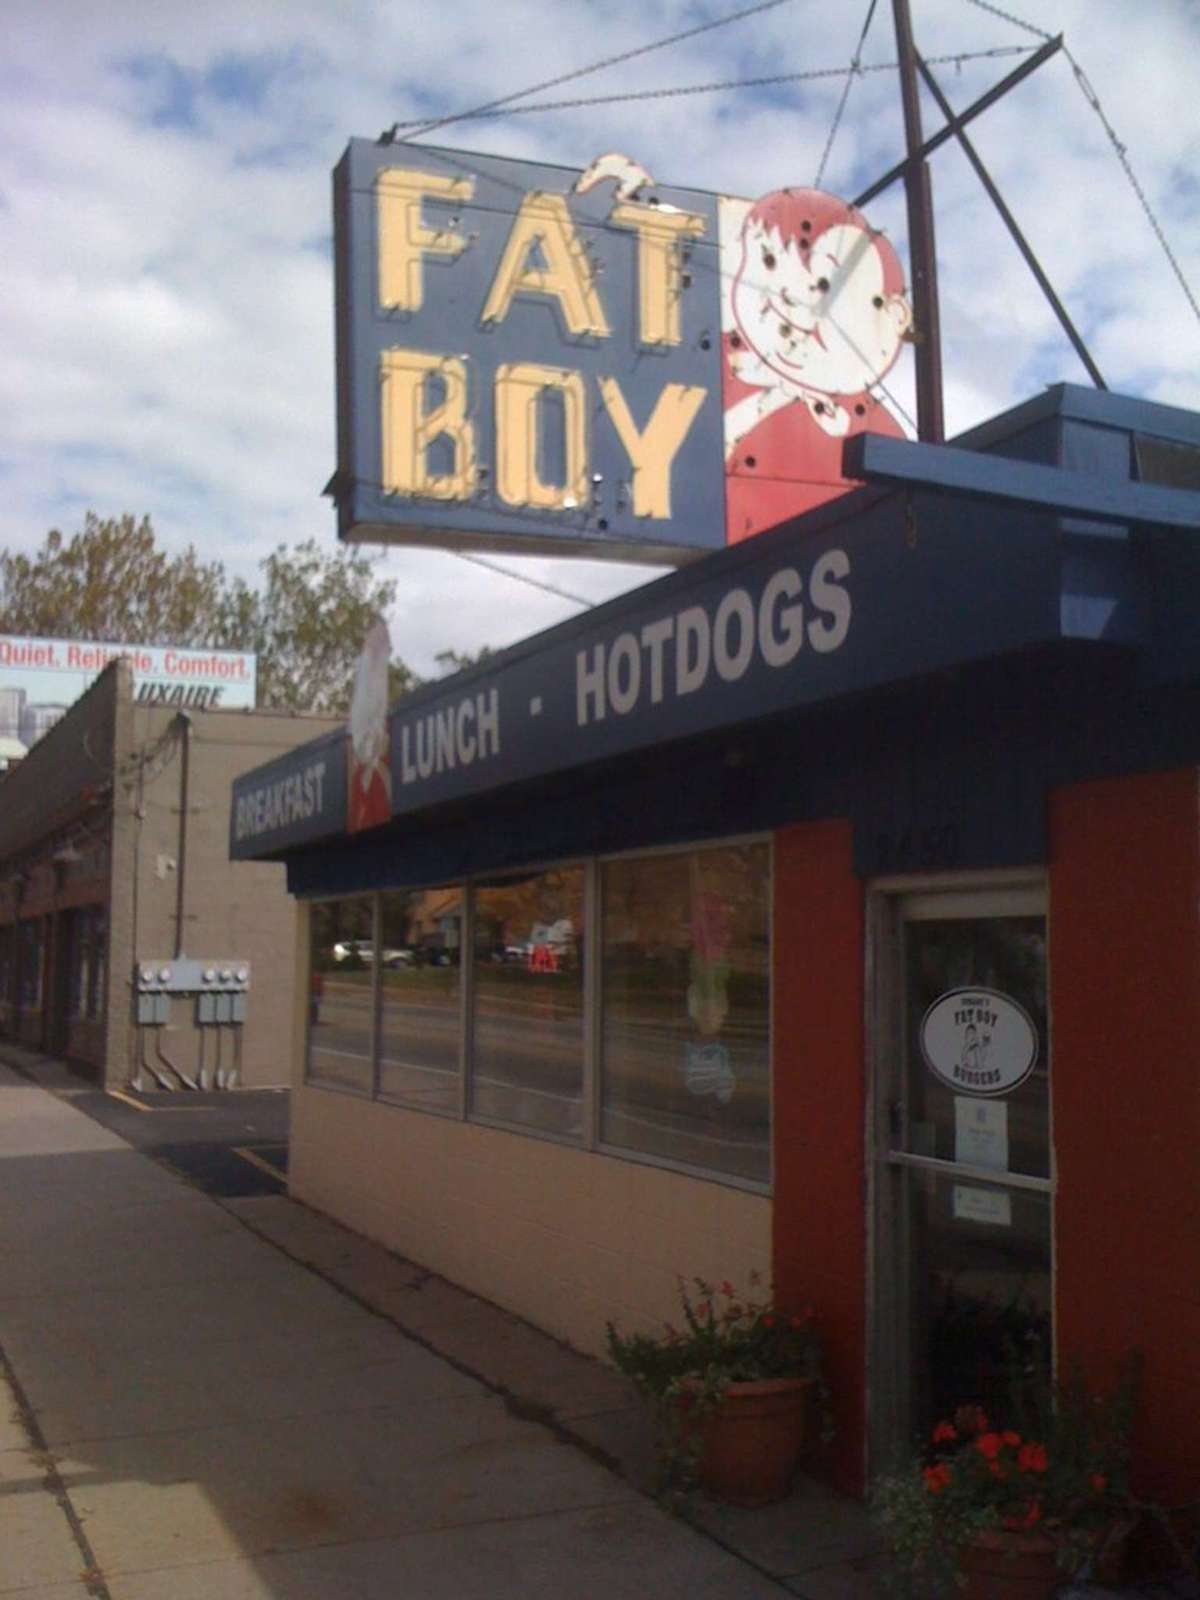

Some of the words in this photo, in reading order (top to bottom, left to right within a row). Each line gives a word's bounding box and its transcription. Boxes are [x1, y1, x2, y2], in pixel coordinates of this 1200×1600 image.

[377, 166, 708, 347] FAT
[379, 347, 708, 520] BOY
[68, 644, 158, 674] Relile,
[137, 681, 225, 707] UXAIRE
[235, 761, 326, 840] BREAKFAST
[401, 688, 500, 784] LUNCH
[575, 549, 852, 728] HOTDOGS
[954, 1008, 974, 1026] FAT
